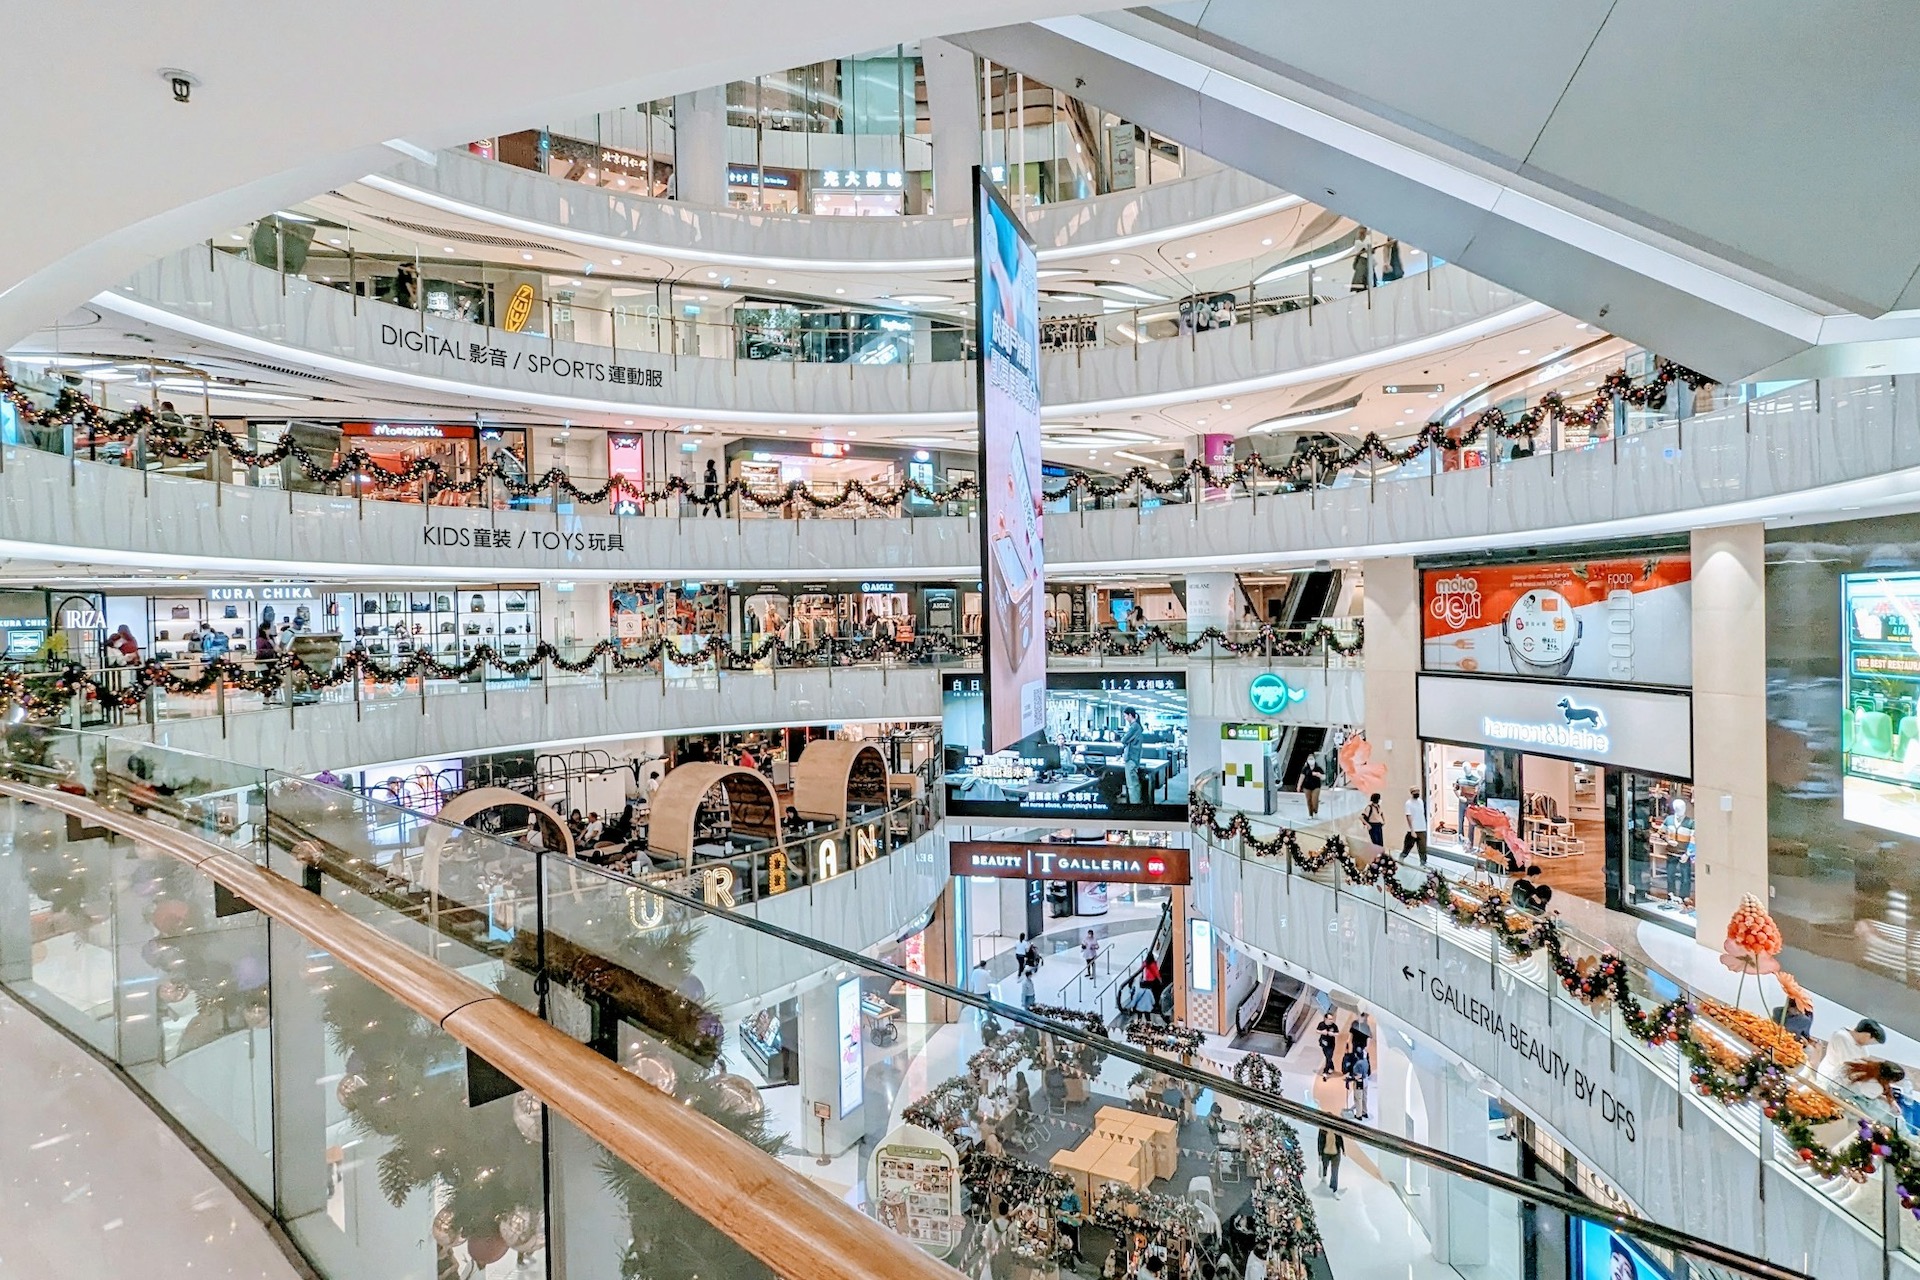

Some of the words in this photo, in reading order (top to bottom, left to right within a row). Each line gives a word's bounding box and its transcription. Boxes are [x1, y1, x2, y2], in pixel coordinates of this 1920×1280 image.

[382, 325, 466, 361] DIGITAL
[468, 343, 508, 369] 影音
[528, 354, 605, 382] SPORTS
[608, 365, 663, 388] 運動服
[423, 526, 470, 548] KIDS
[473, 528, 512, 548] 童裝
[535, 531, 585, 552] TOYS
[588, 533, 624, 552] 玩具
[870, 583, 894, 591] AIGLE
[1607, 573, 1634, 584] FOOD
[210, 587, 255, 600] KURA
[262, 587, 314, 600] CHIKA
[66, 610, 107, 629] IRIZA
[1857, 659, 1869, 668] THE
[1870, 658, 1887, 669] BEST
[1101, 679, 1131, 690] 11.2
[1484, 718, 1609, 753] harmont&blaine
[972, 854, 1022, 867] BEAUTY
[1035, 852, 1057, 873] T
[1058, 857, 1141, 872] GALLERIA
[1148, 862, 1165, 871] DFS
[1418, 969, 1426, 992] T
[1431, 977, 1506, 1043] GALLERIA
[1510, 1022, 1570, 1087] BEAUTY
[1575, 1069, 1596, 1108] BY
[1602, 1089, 1636, 1143] DFS
